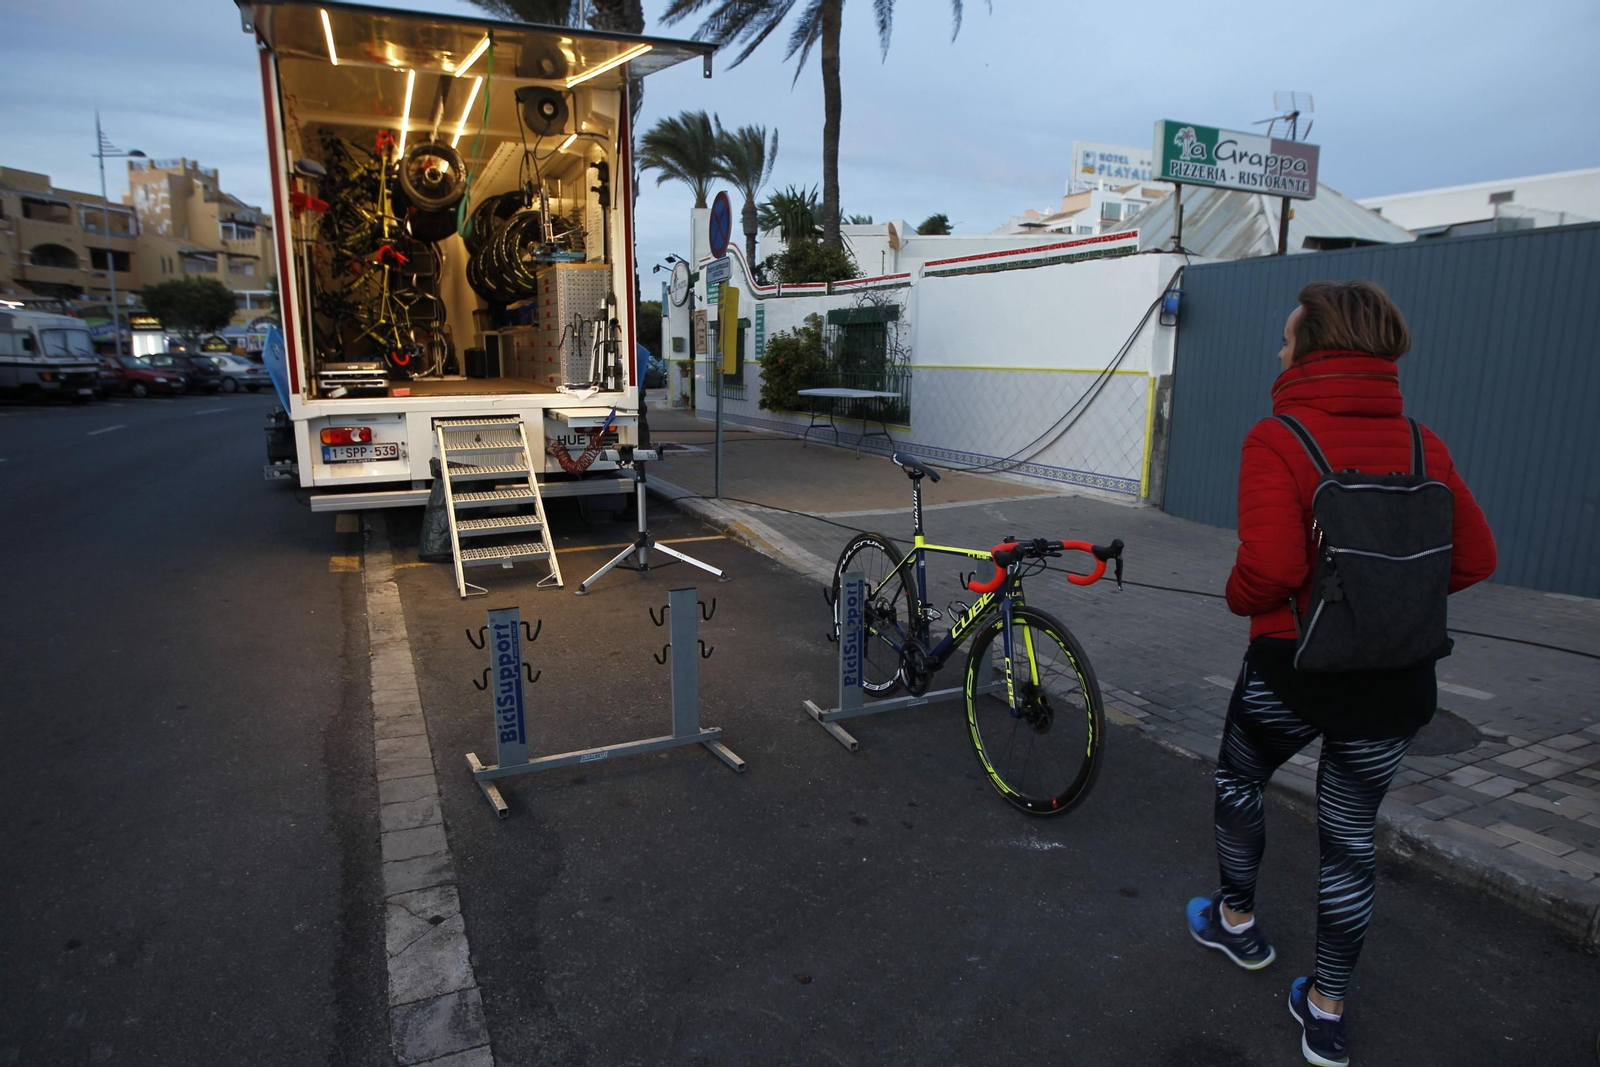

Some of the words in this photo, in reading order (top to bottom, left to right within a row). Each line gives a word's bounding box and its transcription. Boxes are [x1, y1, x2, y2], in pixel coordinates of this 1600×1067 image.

[1099, 152, 1129, 164] HOTEL
[1214, 139, 1308, 176] Grappa
[1170, 160, 1227, 182] PIZZERIA
[1238, 170, 1309, 194] RISTORANTE
[557, 434, 595, 446] HUET
[951, 591, 996, 639] CUBE
[494, 623, 517, 744] BiciSupport
[1004, 657, 1016, 709] CUBE
